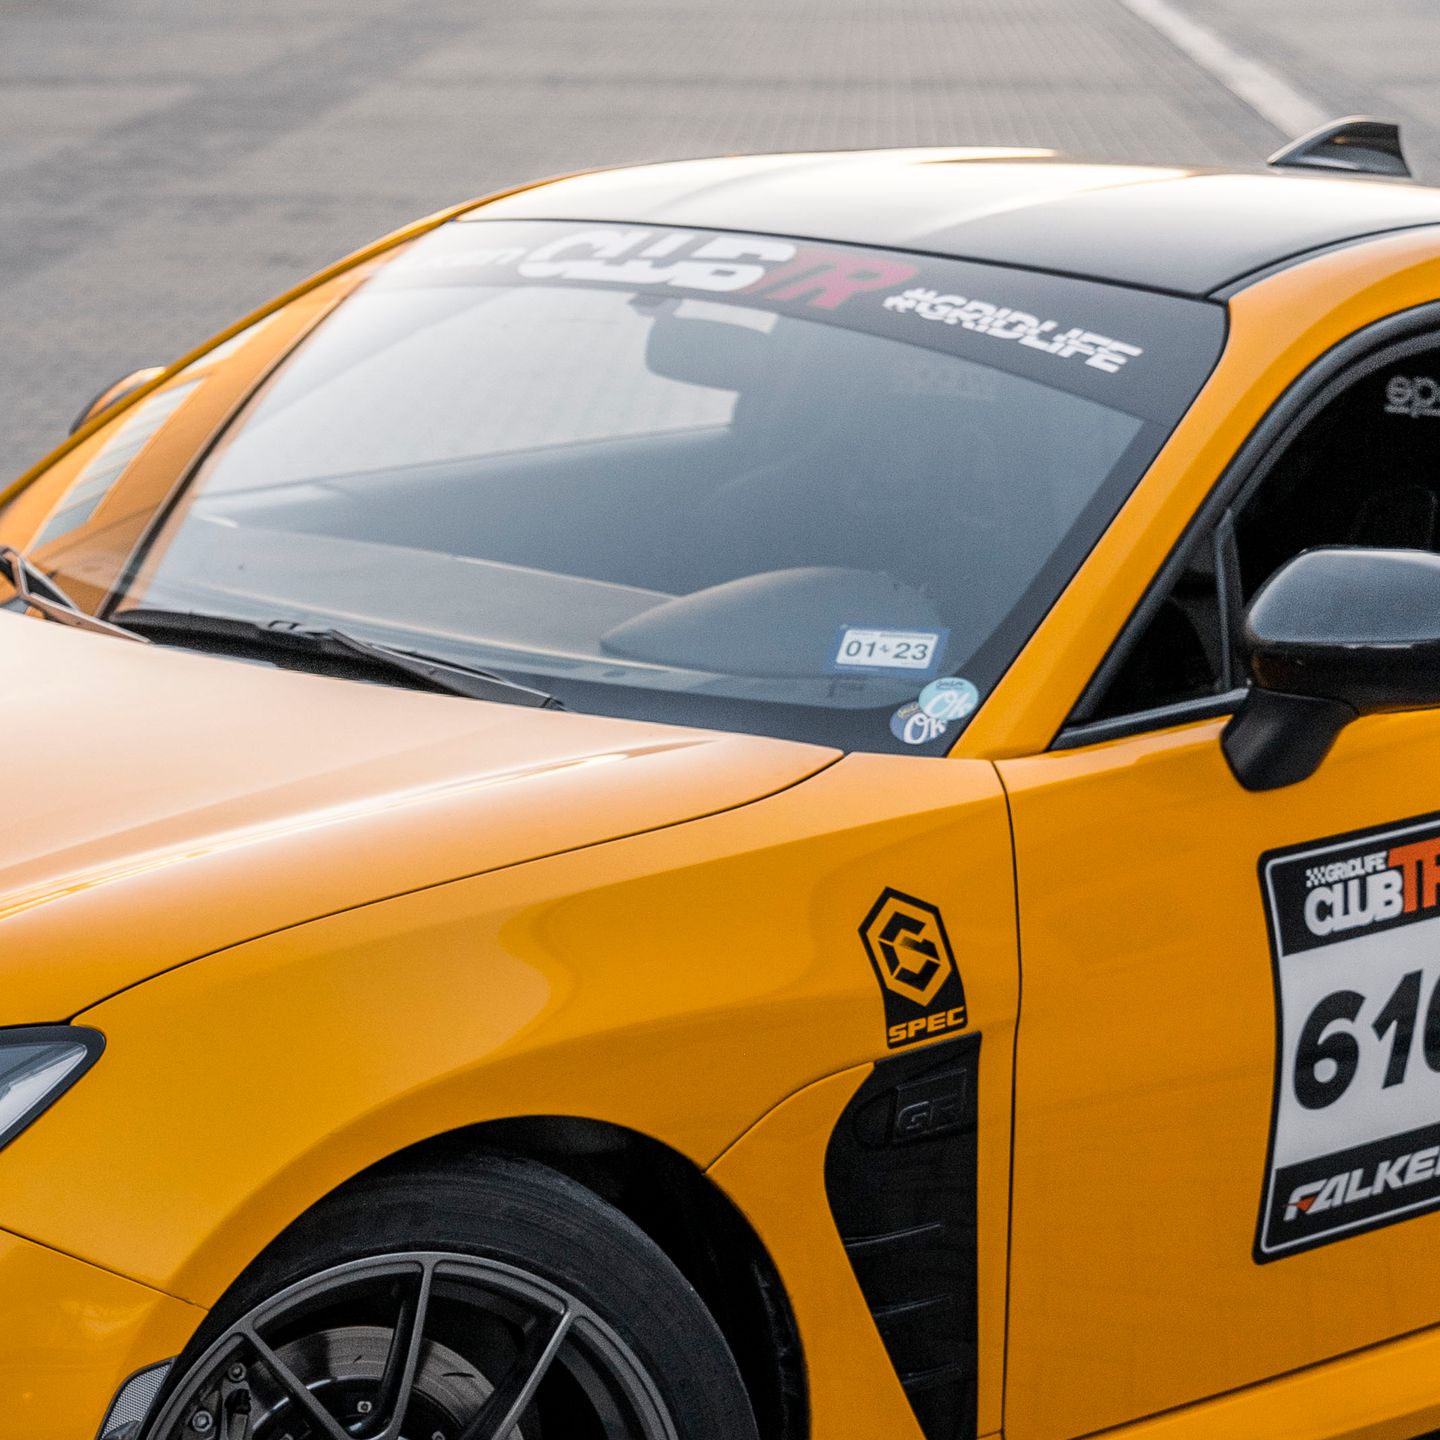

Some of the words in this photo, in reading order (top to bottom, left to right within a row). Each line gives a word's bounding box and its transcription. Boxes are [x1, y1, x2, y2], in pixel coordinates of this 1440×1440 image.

[518, 230, 797, 291] CLUB
[883, 287, 1144, 373] #GRIDLIFE
[1325, 851, 1388, 883] GRIDLIFE
[1304, 869, 1404, 936] CLUB
[888, 1006, 965, 1044] SPEC
[1293, 968, 1440, 1111] 61
[1282, 1145, 1440, 1222] FALKE
